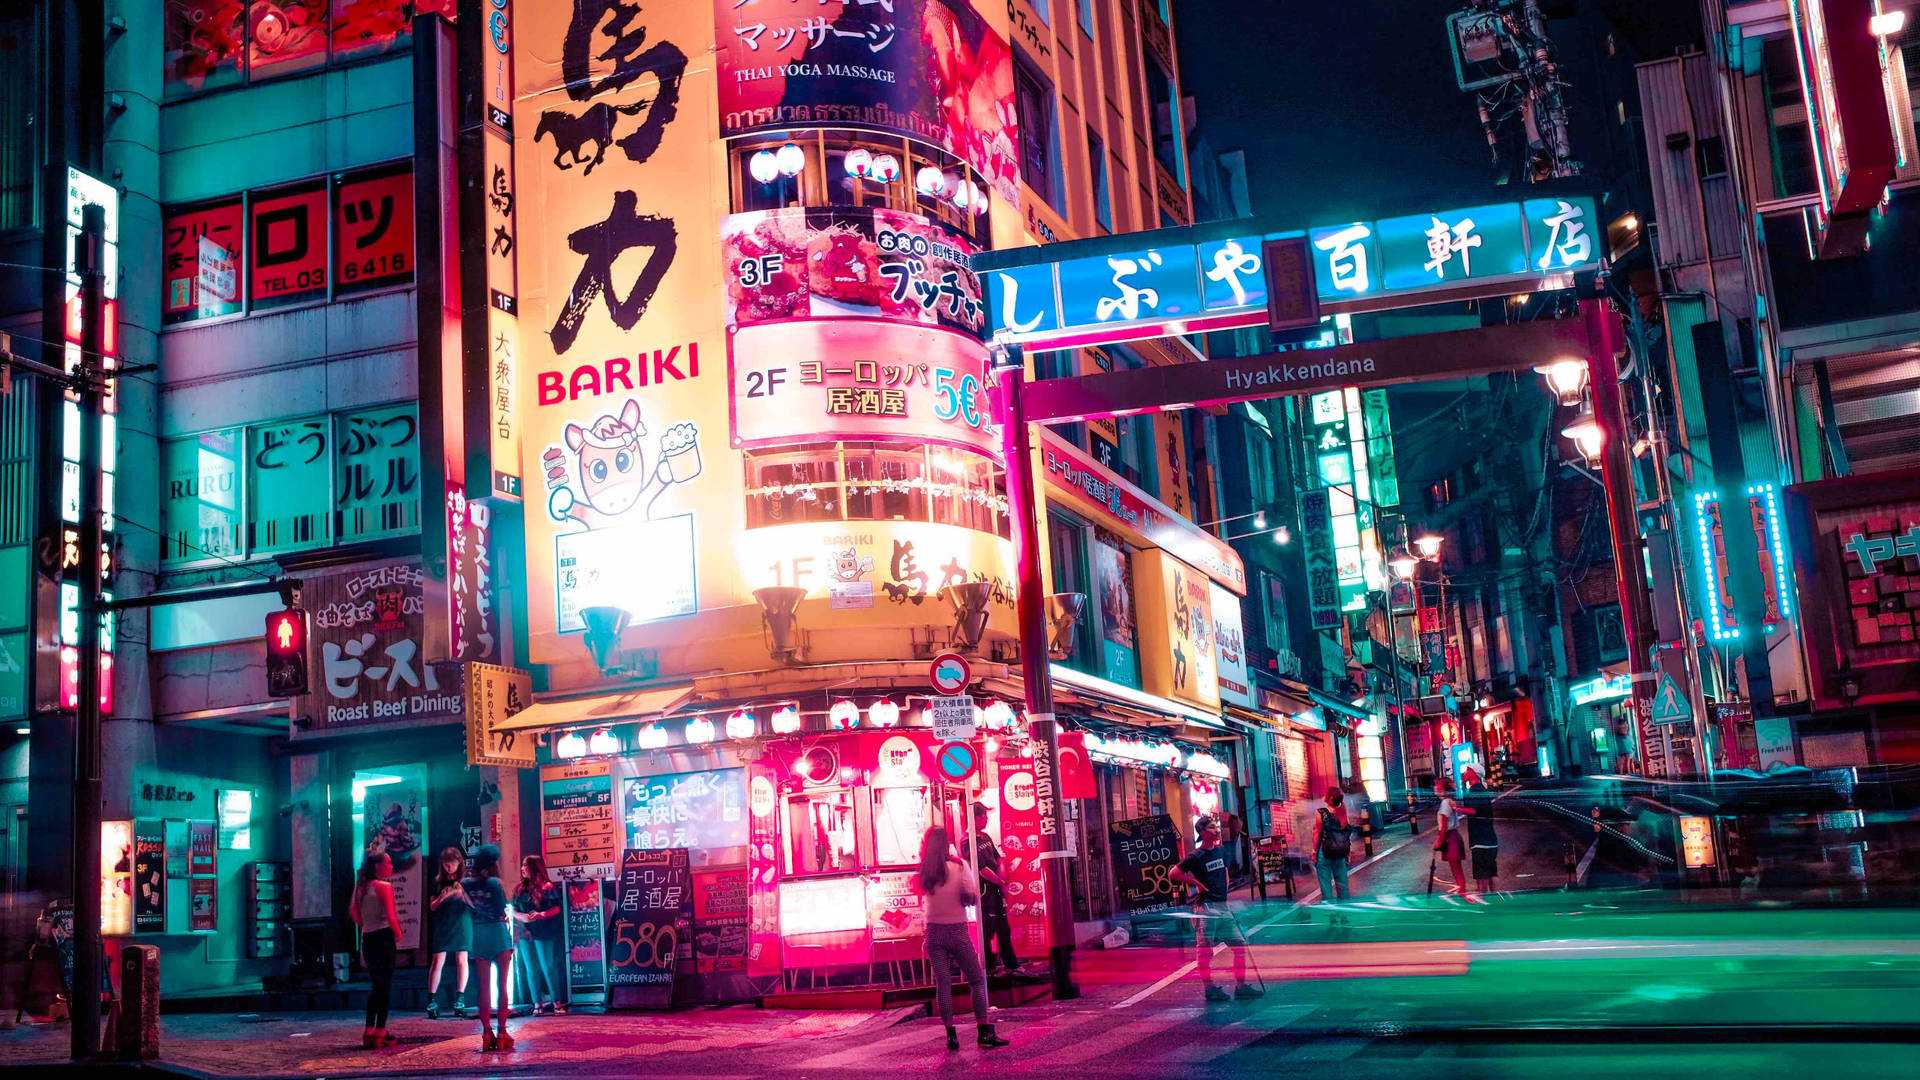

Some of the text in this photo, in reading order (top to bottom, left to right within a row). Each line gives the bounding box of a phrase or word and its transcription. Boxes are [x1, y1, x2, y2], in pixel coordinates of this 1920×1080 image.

[734, 16, 895, 53] マッサージ
[734, 64, 895, 83] THAI YOGA MASSAGE
[493, 110, 508, 126] 2F
[489, 163, 512, 258] 馬力
[878, 231, 928, 256] お肉の
[262, 253, 405, 293] TEL.03 6416
[740, 255, 783, 288] 3F
[497, 293, 512, 311] 1F
[879, 260, 984, 324] ブッチャ
[494, 331, 511, 441] 大衆屋台
[538, 342, 699, 406] BARIKI
[746, 368, 787, 399] 2F
[800, 361, 928, 388] ヨーロッパ
[1226, 356, 1376, 389] Hyakkendana
[826, 388, 906, 417] 居酒屋
[934, 368, 980, 428] 5€
[256, 413, 417, 468] どうぶつ
[1099, 441, 1111, 470] 3F
[170, 472, 233, 499] RURU
[338, 455, 417, 504] ルル
[502, 475, 516, 494] 1F
[1048, 452, 1107, 504] ヨーロッパ居酒屋
[823, 535, 873, 546] BARIKI
[469, 503, 495, 658] ローストビーフ
[769, 557, 814, 587] 1F
[882, 539, 967, 606] 馬力
[1174, 568, 1189, 690] 馬力
[328, 694, 461, 723] Roast Beef Dining
[597, 793, 610, 803] 5F
[1031, 739, 1056, 836] 渋谷百軒店
[602, 836, 611, 844] 2F
[1120, 834, 1165, 852] ヨーロッパ
[137, 863, 148, 874] 3F
[603, 852, 611, 860] 1F
[1127, 847, 1171, 866] FOOD
[625, 868, 684, 885] ヨーロッパ
[1142, 863, 1176, 896] 58
[621, 886, 682, 912] 居酒屋
[612, 921, 677, 968] 580
[609, 973, 649, 983] EUROPEAN
